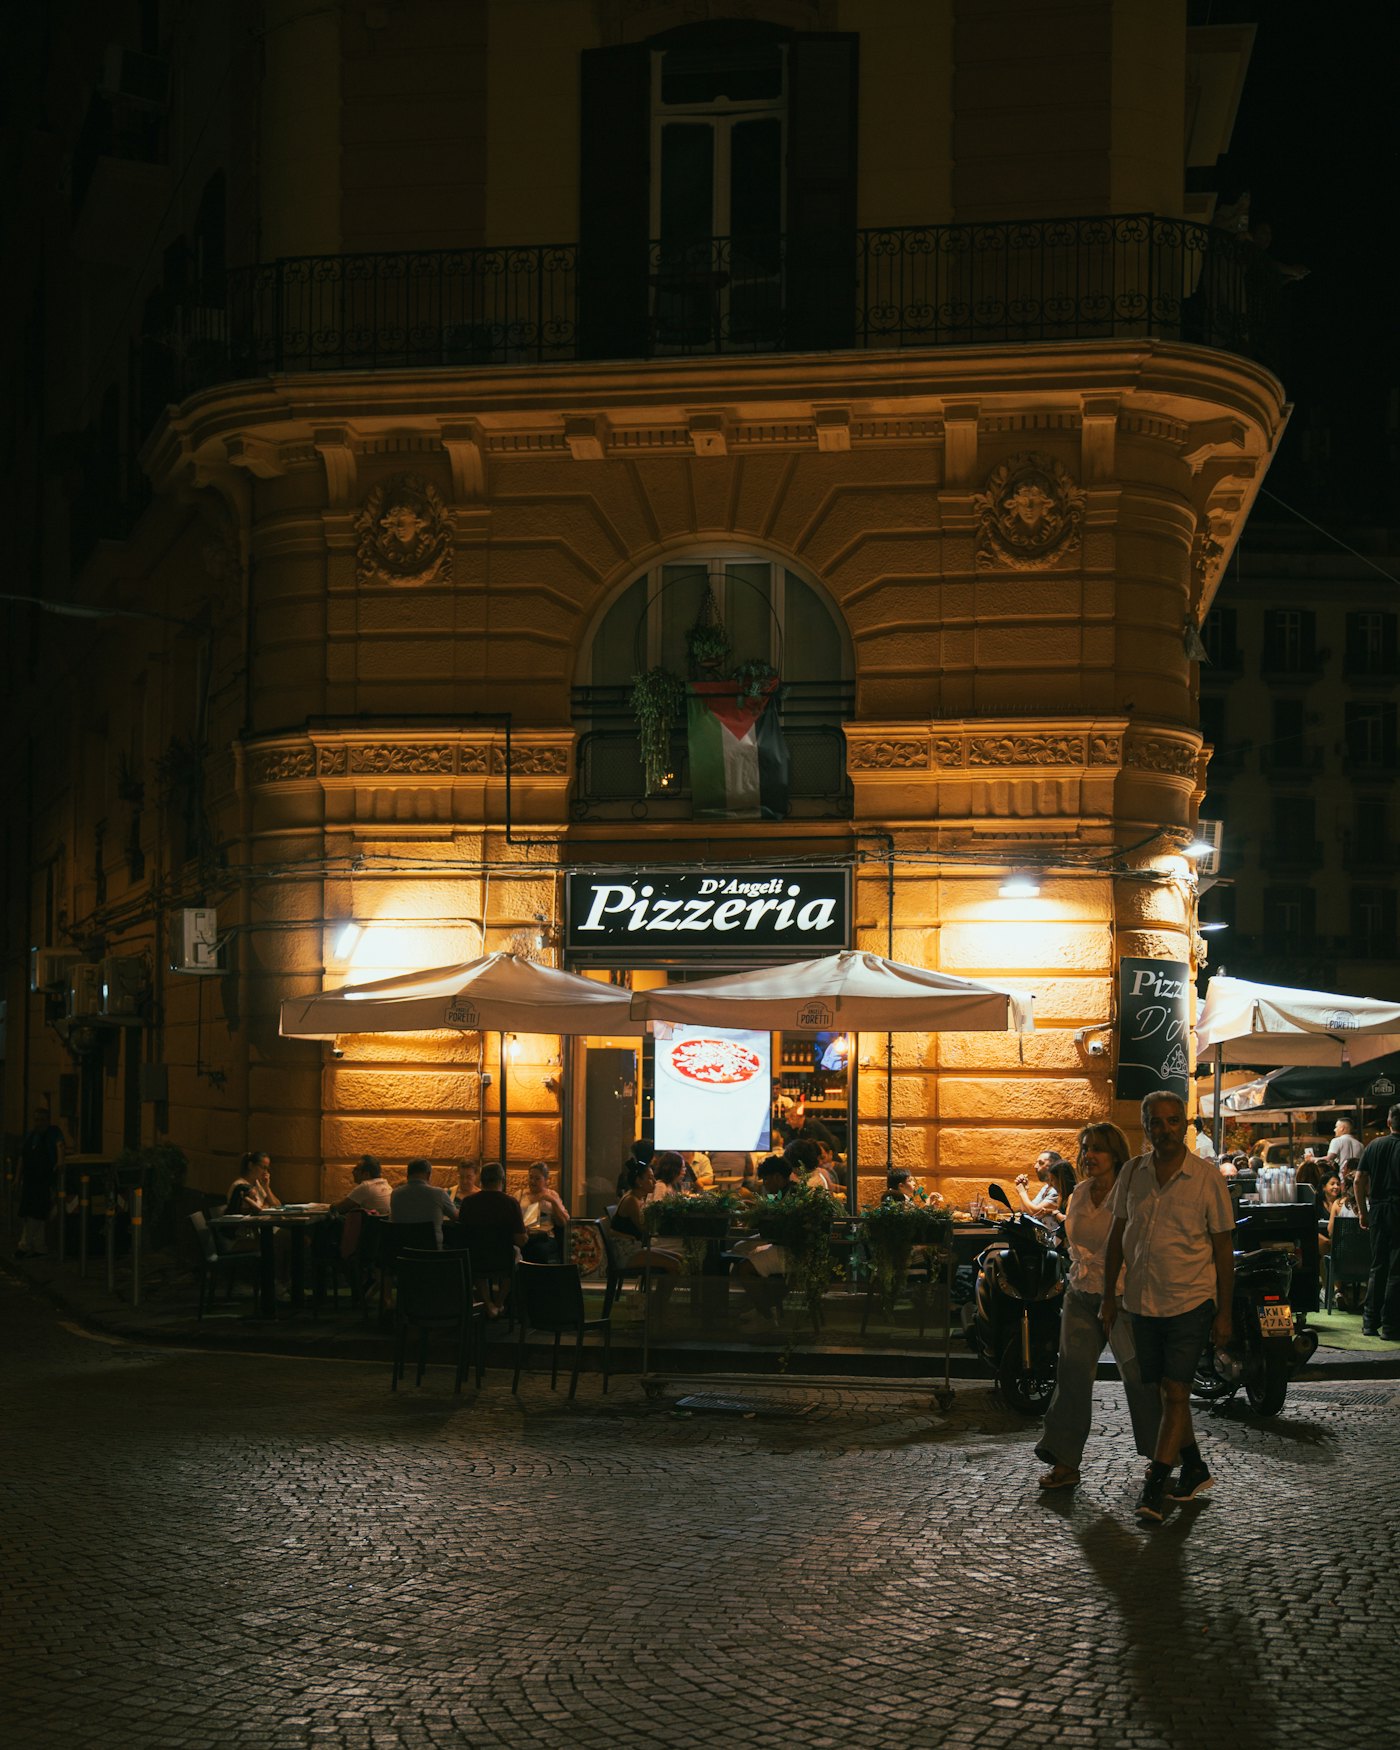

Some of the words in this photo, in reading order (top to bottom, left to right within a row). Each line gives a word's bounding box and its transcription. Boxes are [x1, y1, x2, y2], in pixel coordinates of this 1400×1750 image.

[698, 878, 784, 896] D'Angeli
[577, 884, 837, 932] Pizzeria
[1129, 969, 1187, 999] Pizz
[448, 1012, 476, 1022] PORETTI
[800, 1014, 828, 1024] PORETTI
[1329, 1020, 1356, 1031] PORETTI
